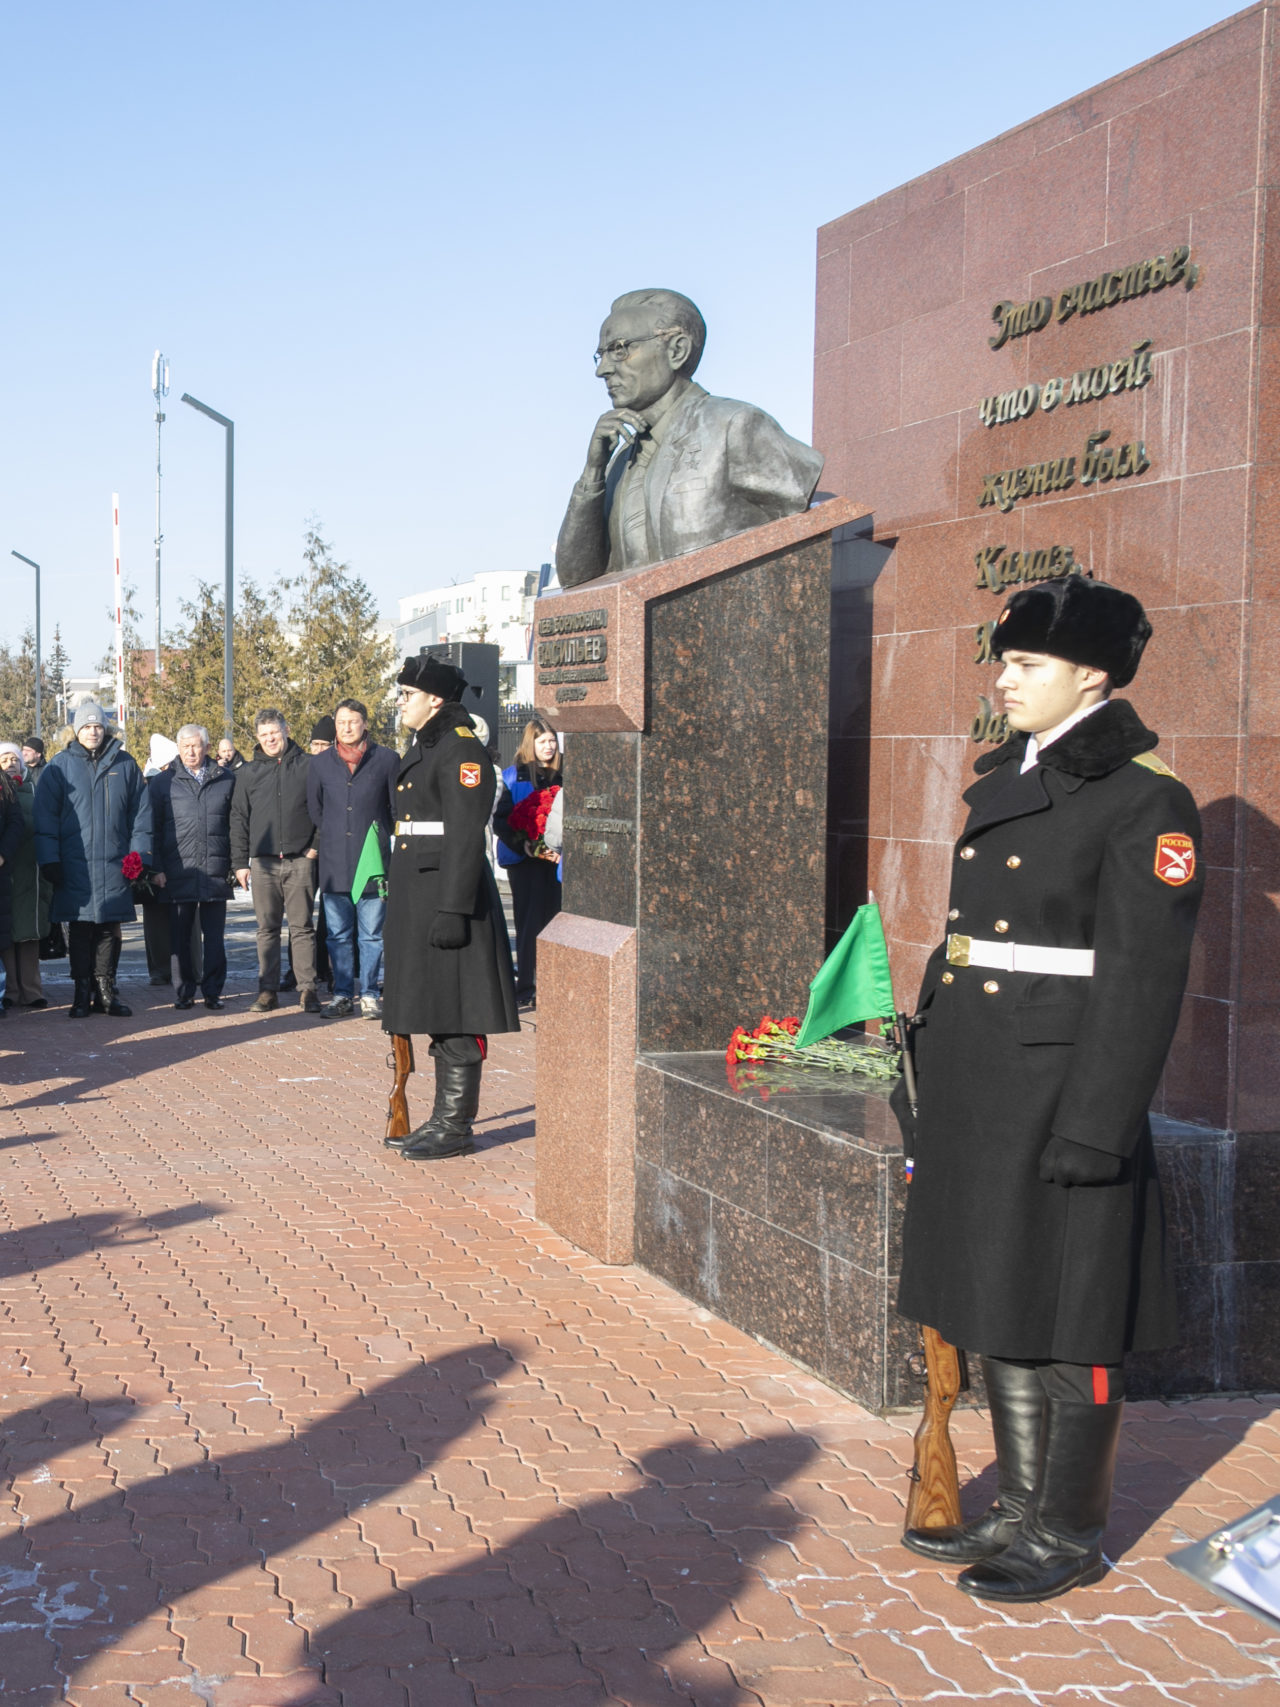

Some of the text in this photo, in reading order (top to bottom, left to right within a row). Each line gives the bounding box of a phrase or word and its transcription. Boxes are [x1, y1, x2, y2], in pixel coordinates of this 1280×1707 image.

[988, 246, 1199, 350] Это счастье,
[977, 338, 1153, 428] что в моей
[976, 430, 1151, 513] жизни был
